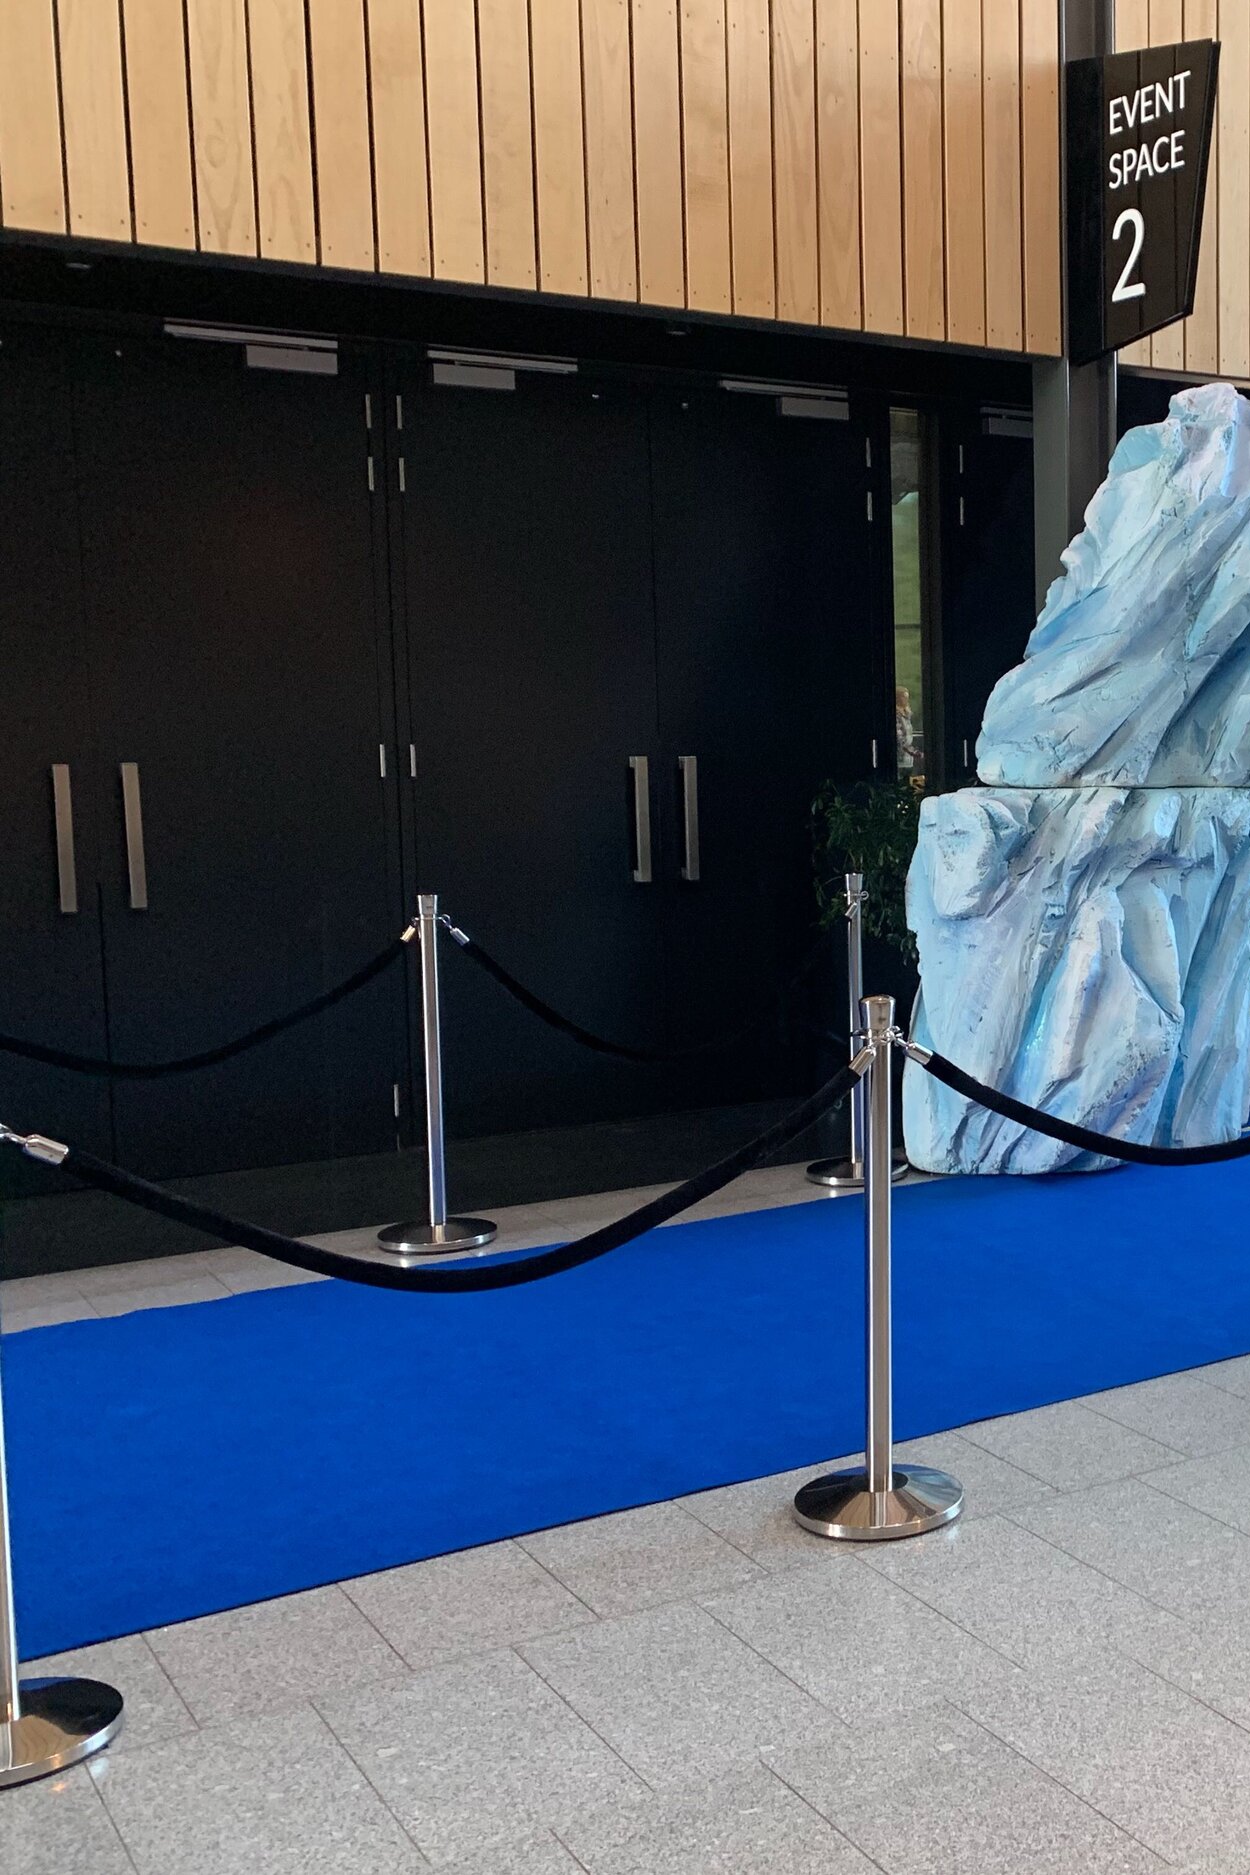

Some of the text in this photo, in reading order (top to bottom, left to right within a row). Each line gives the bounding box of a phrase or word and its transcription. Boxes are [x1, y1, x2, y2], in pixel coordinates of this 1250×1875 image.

[1108, 70, 1192, 135] EVENT
[1108, 130, 1186, 189] SPACE
[1111, 208, 1146, 302] 2
